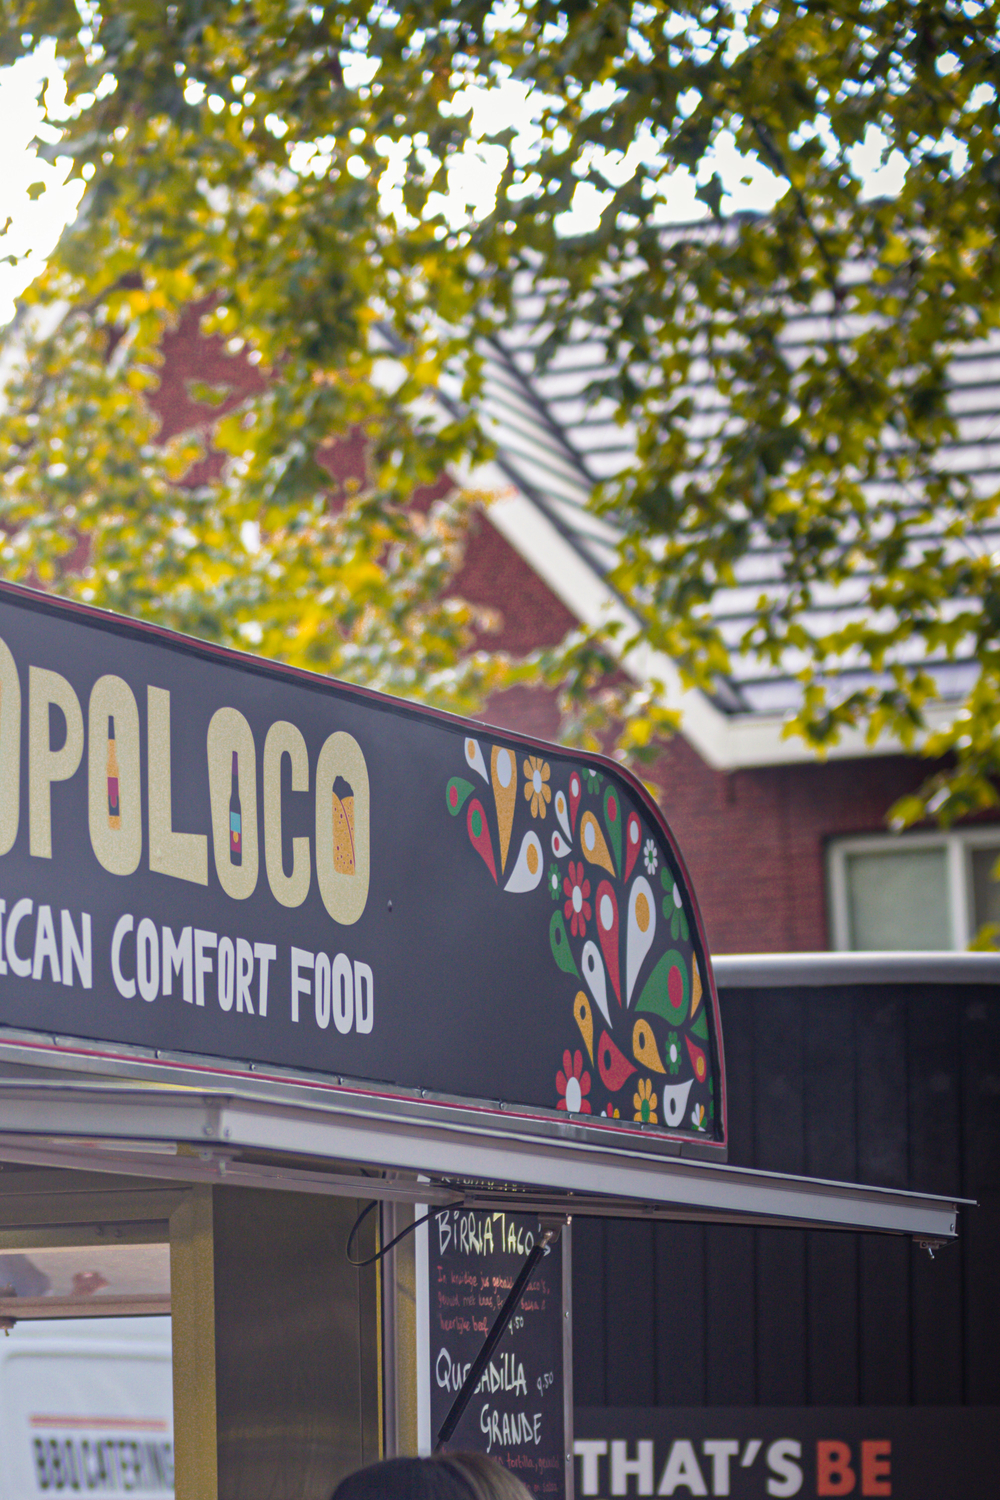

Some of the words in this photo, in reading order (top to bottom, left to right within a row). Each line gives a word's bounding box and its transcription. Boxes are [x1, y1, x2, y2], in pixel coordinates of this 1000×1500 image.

[110, 912, 277, 1017] COMFORT
[290, 945, 374, 1035] FOOD
[480, 1403, 542, 1454] GRANDE
[574, 1439, 804, 1498] THAT'S
[816, 1440, 892, 1496] BE
